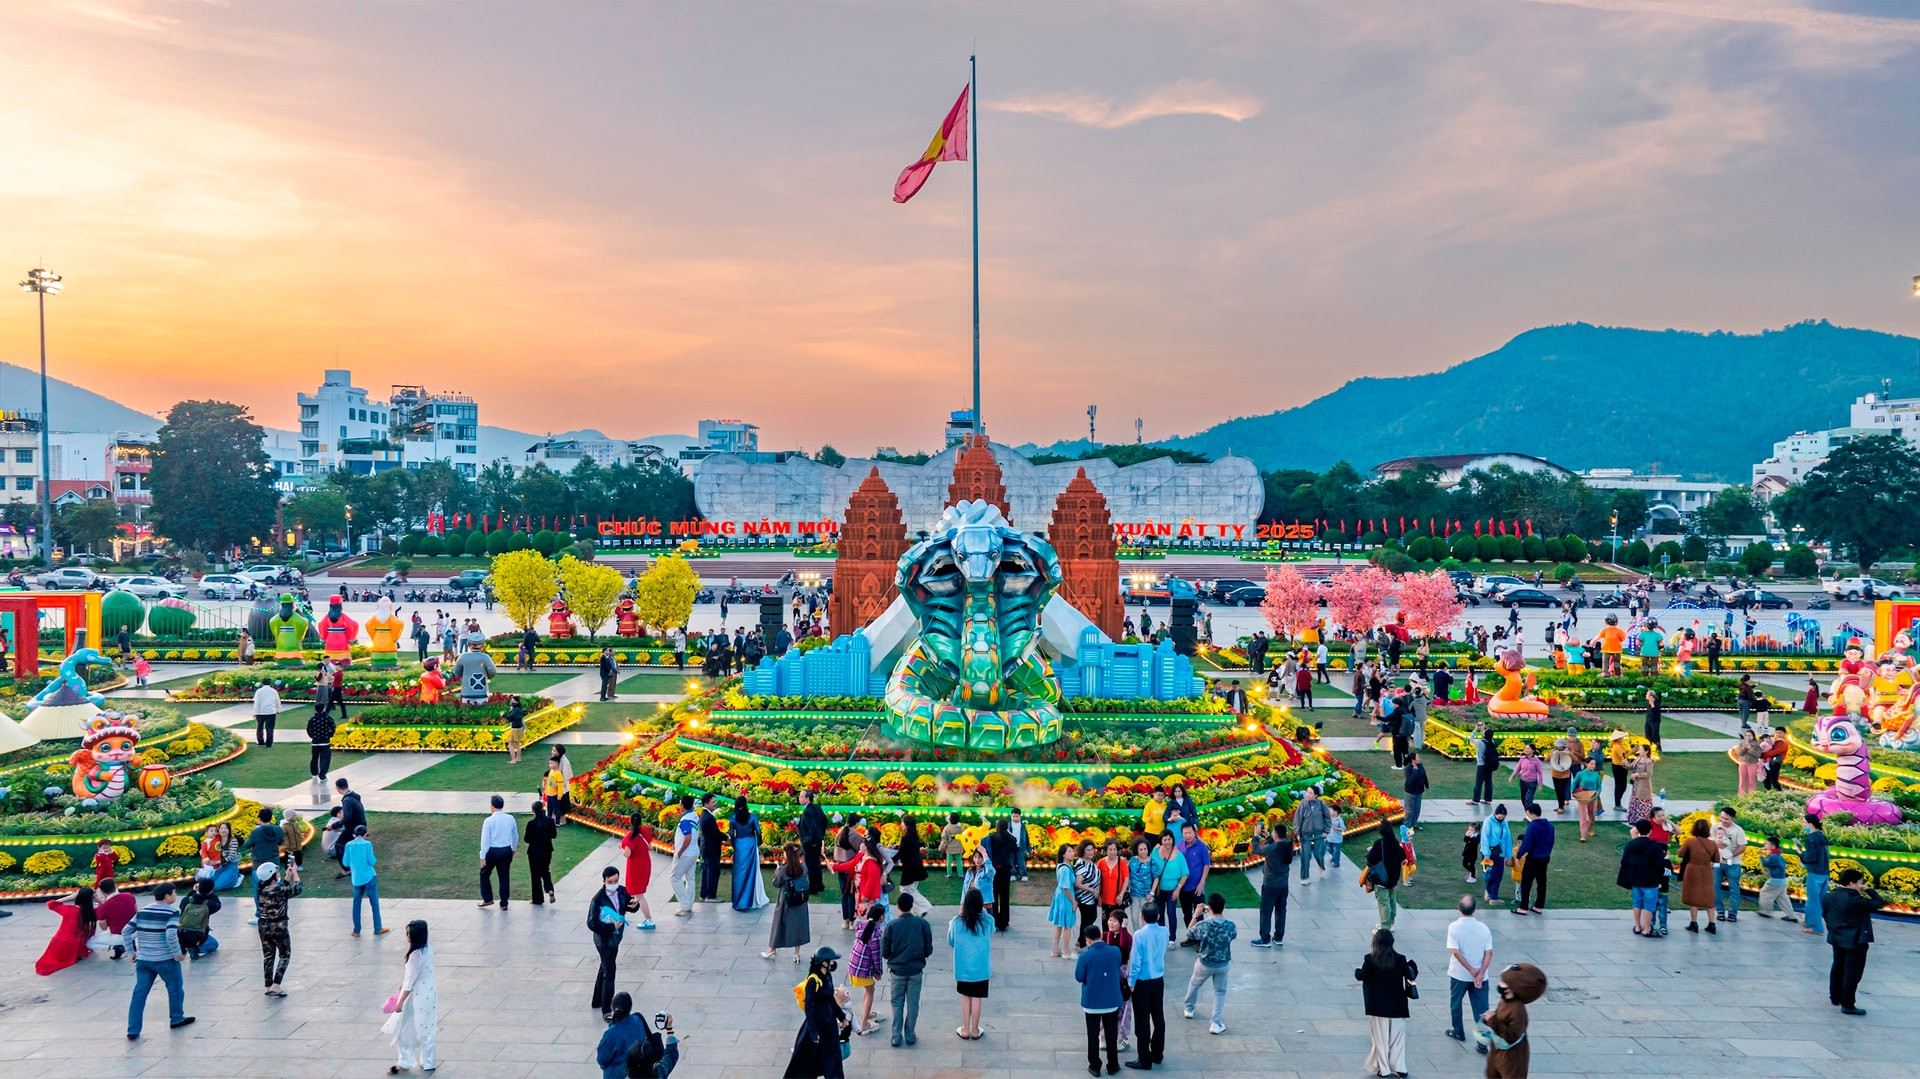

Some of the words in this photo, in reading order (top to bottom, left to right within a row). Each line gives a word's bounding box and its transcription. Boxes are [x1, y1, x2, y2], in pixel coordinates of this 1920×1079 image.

[598, 517, 662, 535] CHÚC
[670, 517, 736, 535] MỪNG
[743, 517, 791, 535] NĂM
[1114, 519, 1171, 536] XUÂN
[1179, 517, 1209, 537] ẤT
[1256, 524, 1314, 539] 2025
